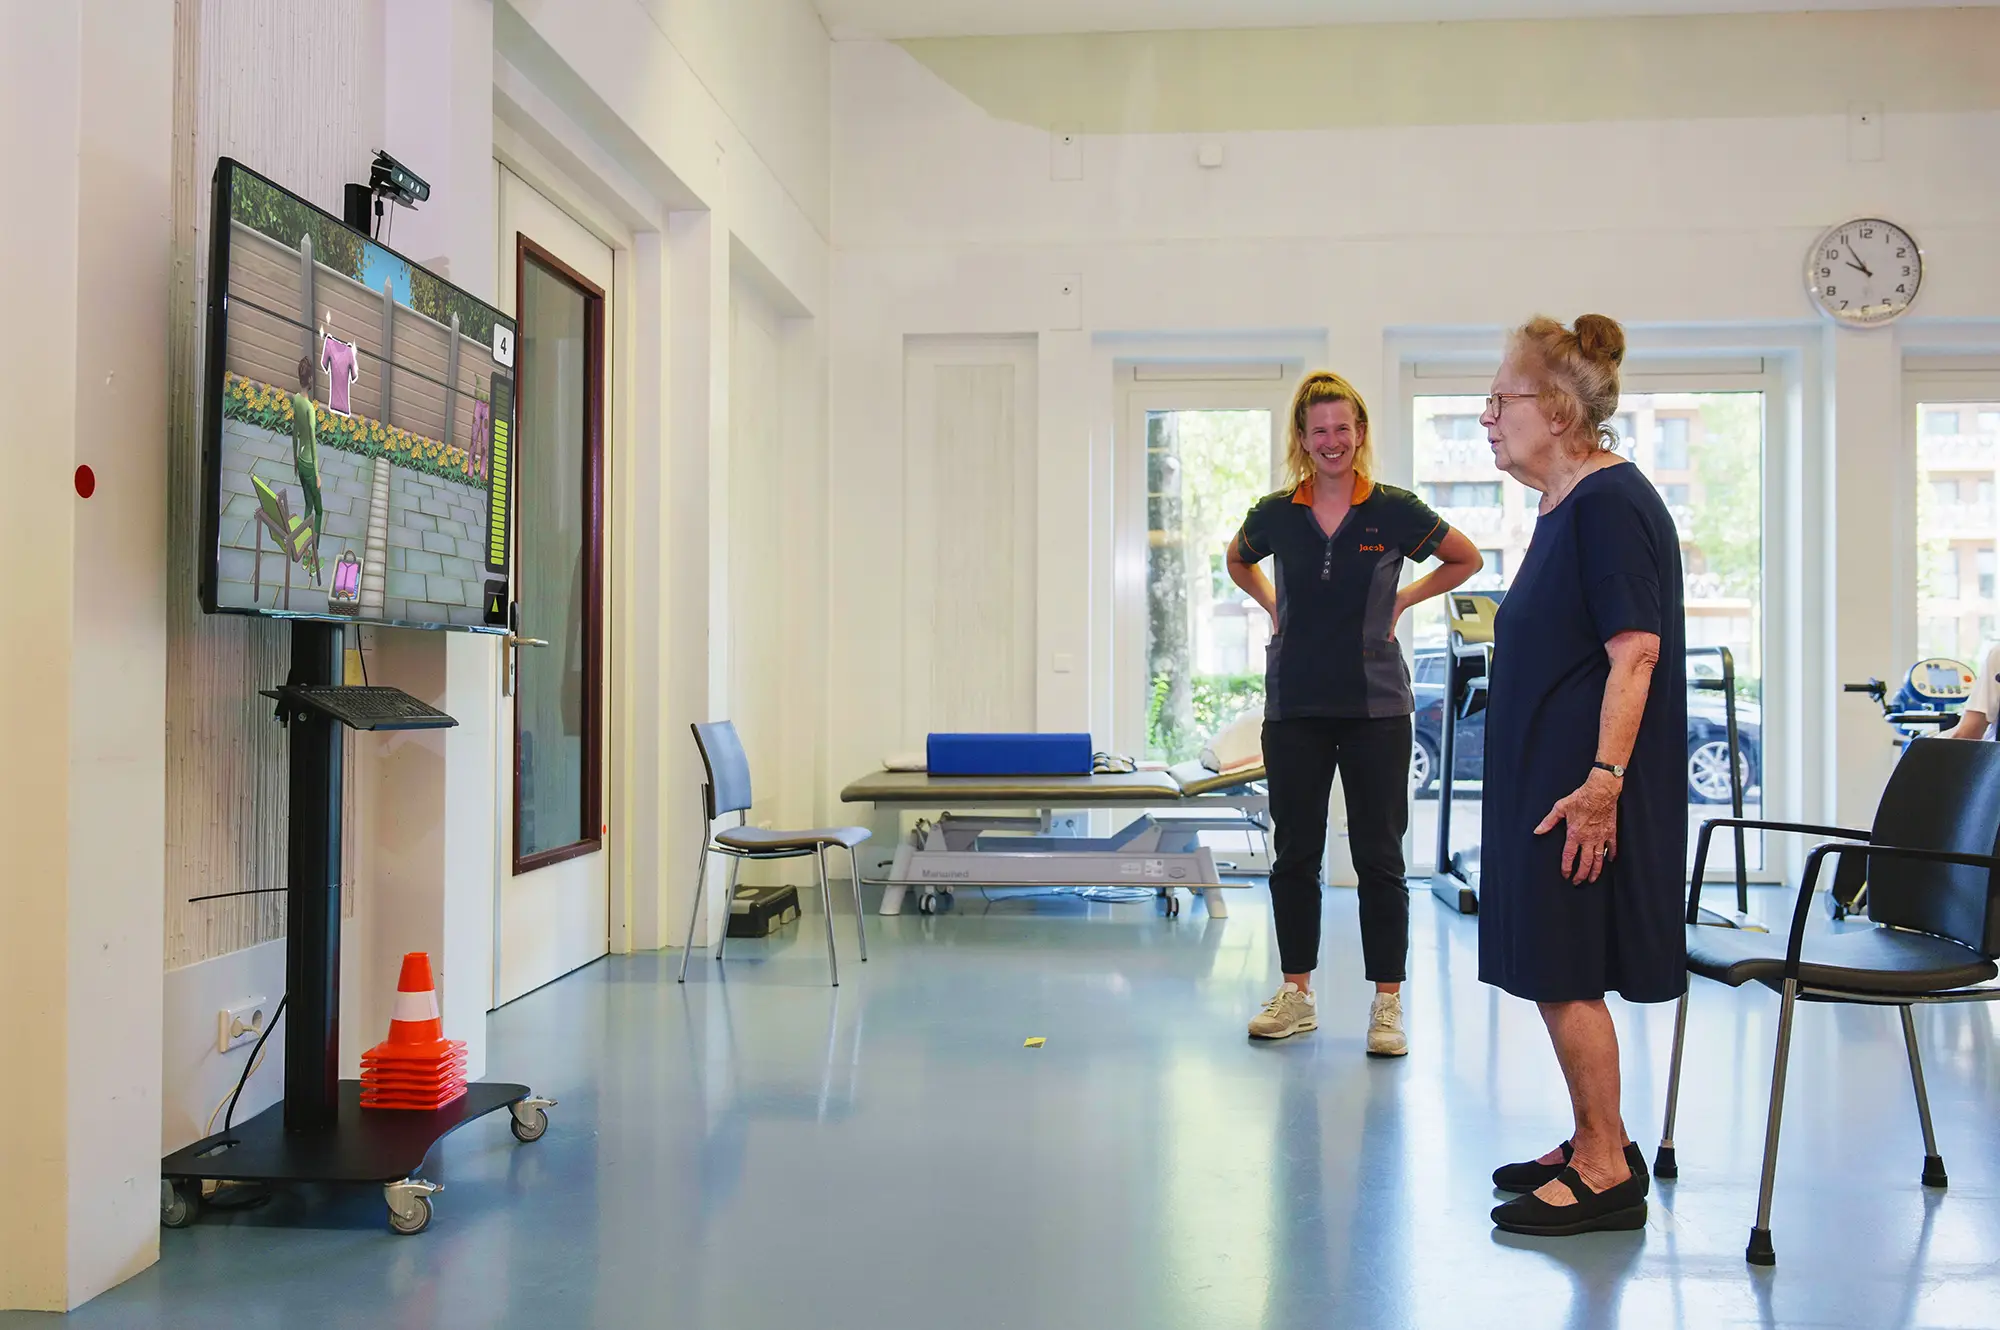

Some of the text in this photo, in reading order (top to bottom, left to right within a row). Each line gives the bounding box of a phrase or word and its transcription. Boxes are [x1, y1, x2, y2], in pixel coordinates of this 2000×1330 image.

[1859, 228, 1873, 239] 12
[1885, 234, 1889, 244] 1
[1840, 235, 1849, 245] 11
[1826, 249, 1839, 260] 10
[1896, 247, 1906, 258] 2
[1821, 267, 1831, 278] 9
[1901, 266, 1910, 277] 3
[1826, 286, 1836, 296] 8
[1895, 283, 1905, 293] 4
[1840, 300, 1849, 311] 7
[1882, 298, 1891, 308] 5
[1861, 305, 1870, 316] 6
[500, 336, 507, 355] 4
